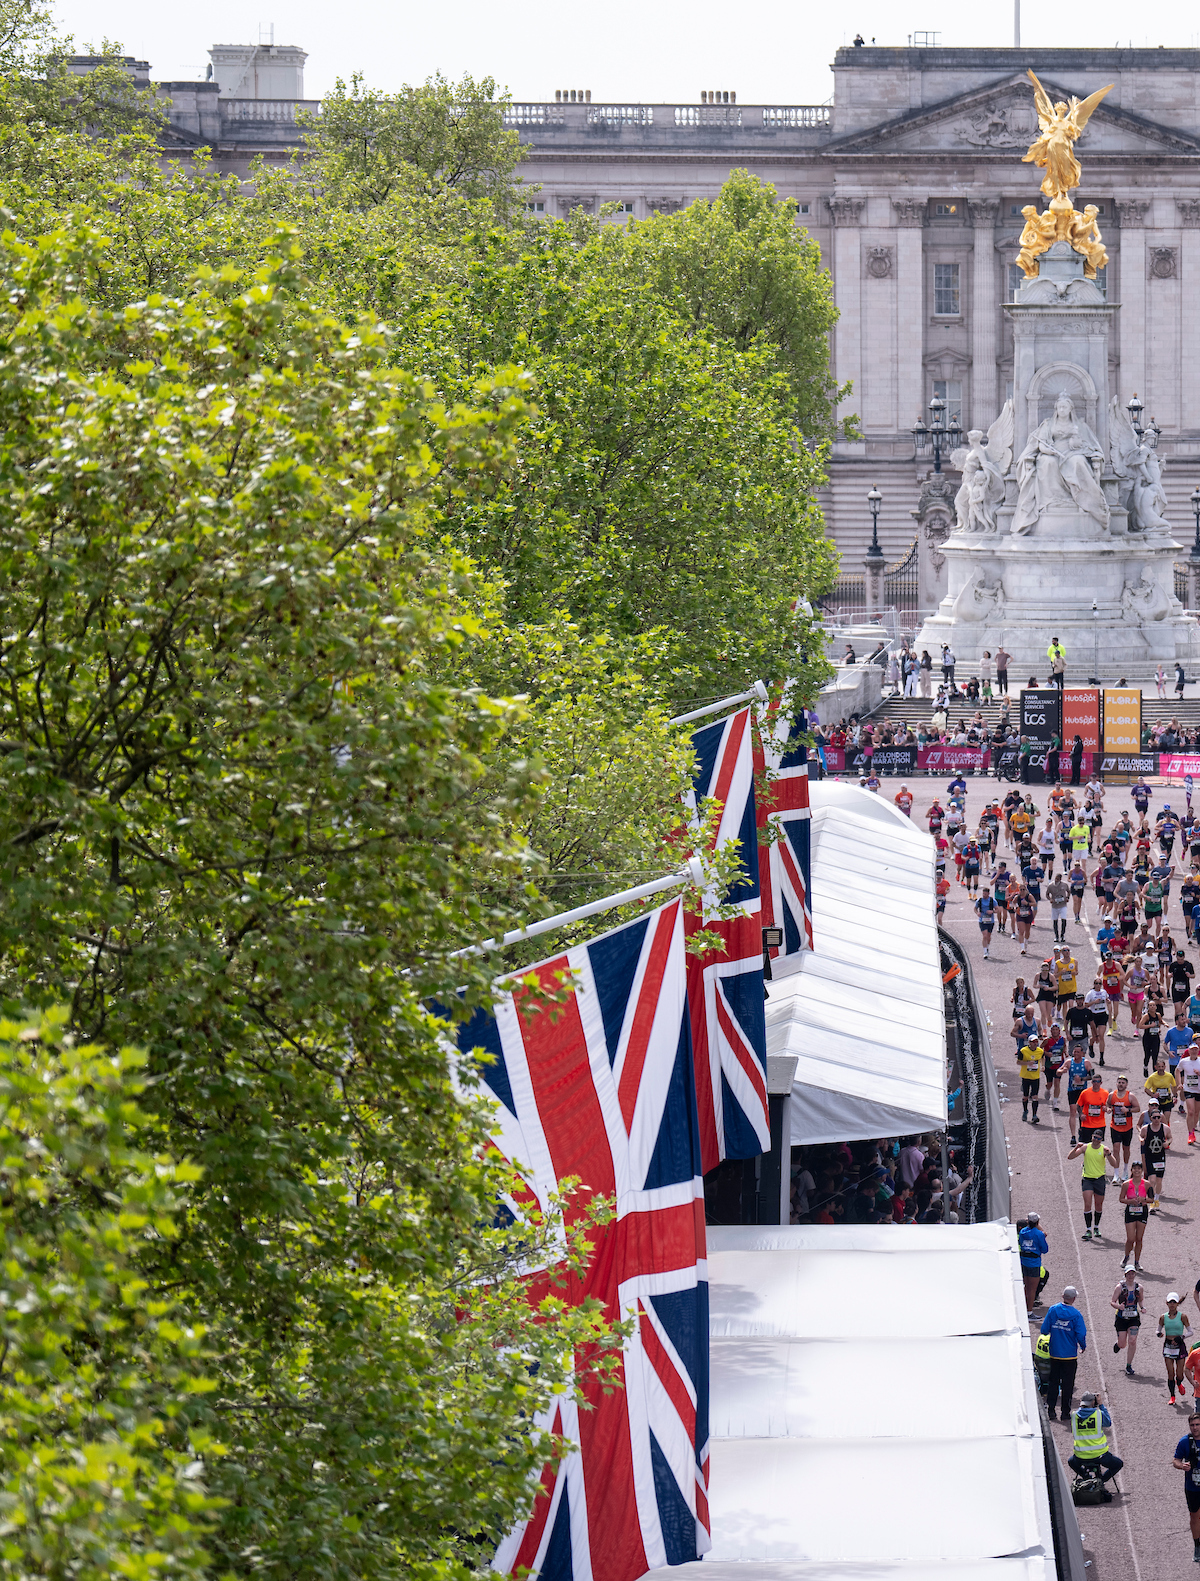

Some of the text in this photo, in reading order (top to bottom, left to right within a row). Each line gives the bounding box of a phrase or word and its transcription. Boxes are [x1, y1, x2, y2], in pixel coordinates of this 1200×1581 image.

[1064, 694, 1096, 702] HubSpot
[1106, 696, 1138, 704] FLORA
[1024, 711, 1046, 725] tcs
[1064, 716, 1096, 725] HubSpot
[1106, 716, 1138, 725] FLORA
[1106, 736, 1138, 745] FLORA
[1028, 754, 1046, 766] cs
